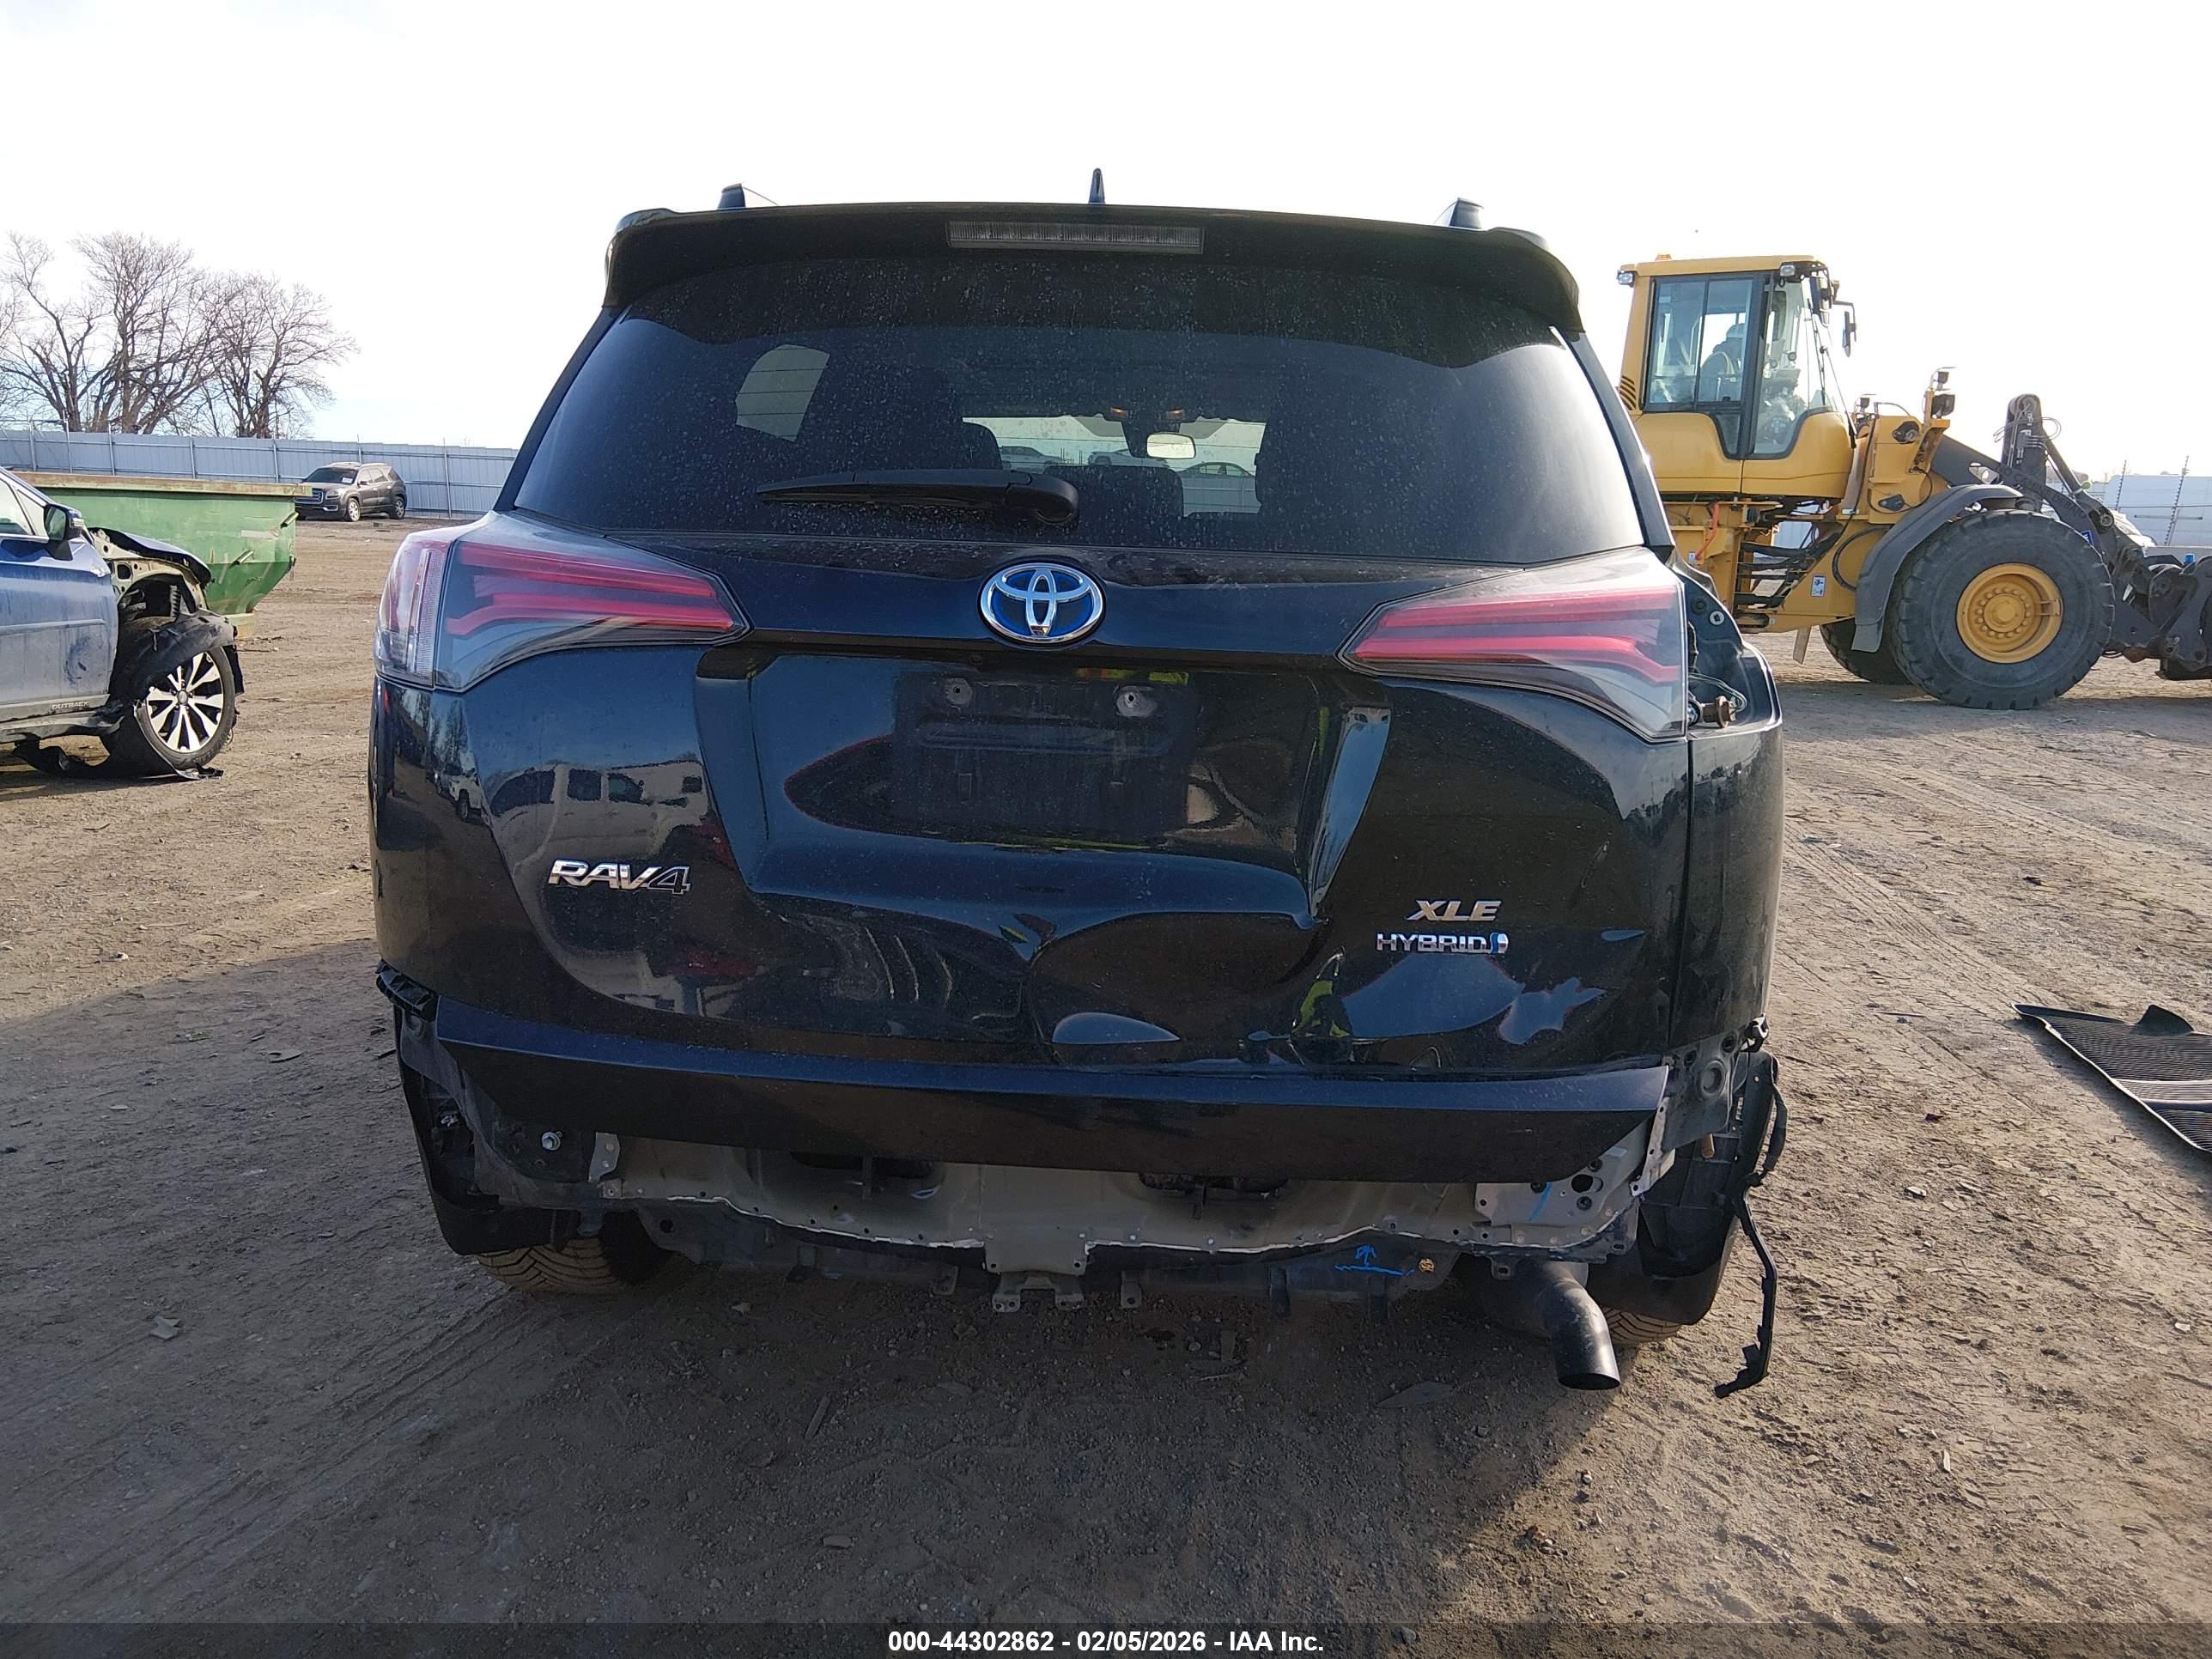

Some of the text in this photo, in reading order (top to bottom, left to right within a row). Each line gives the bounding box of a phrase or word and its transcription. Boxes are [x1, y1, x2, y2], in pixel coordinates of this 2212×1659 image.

[548, 859, 692, 896] RAV4
[1406, 899, 1502, 922] XLE
[1376, 933, 1490, 954] HYBRID
